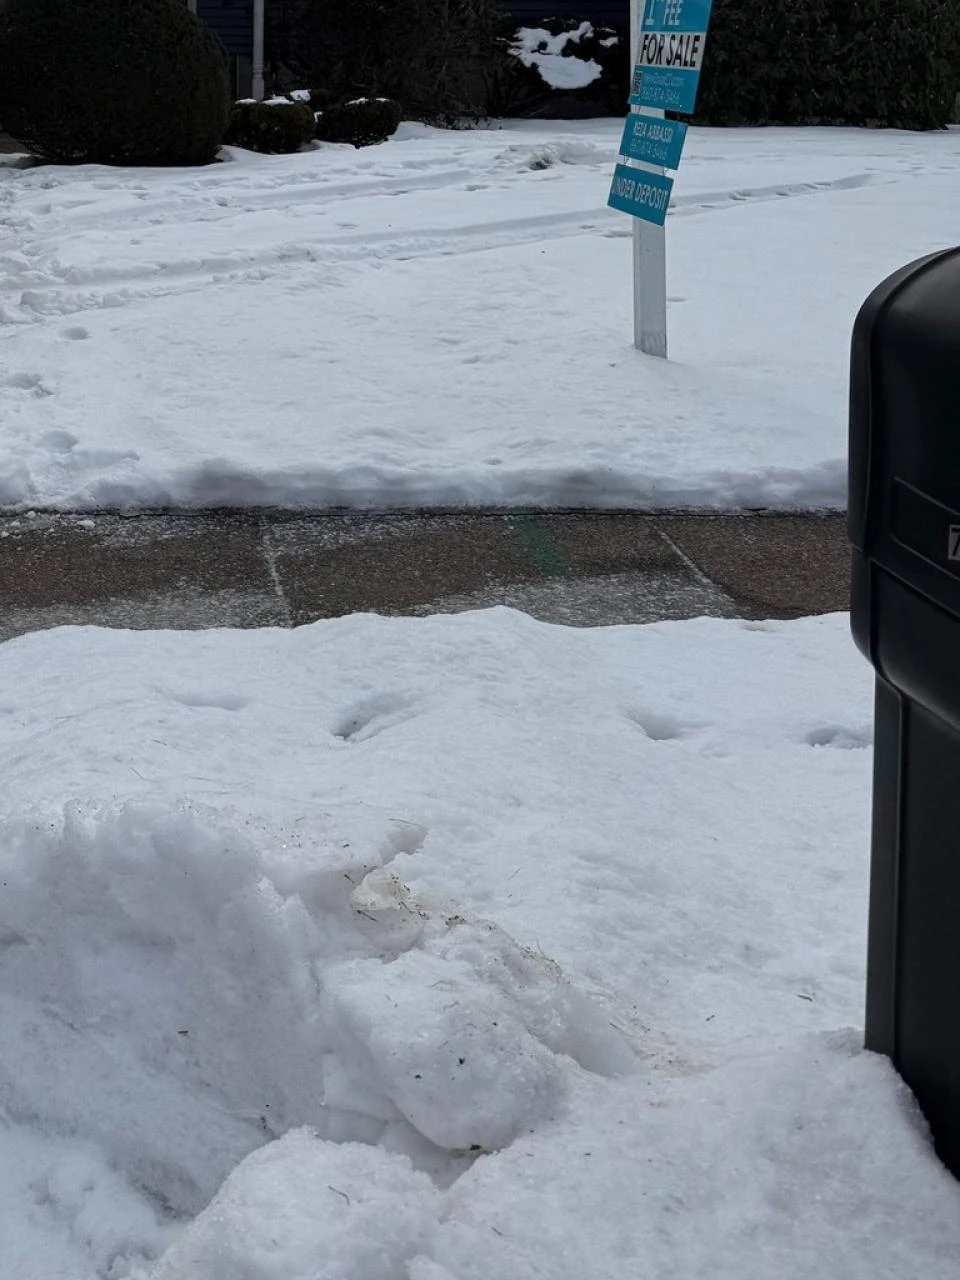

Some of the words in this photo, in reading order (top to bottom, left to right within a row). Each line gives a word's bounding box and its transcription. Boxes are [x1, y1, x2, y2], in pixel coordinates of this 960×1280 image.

[640, 33, 665, 65] FOR
[666, 33, 700, 68] SALE
[611, 176, 636, 200] UNDER
[634, 182, 669, 210] DEPOSIT
